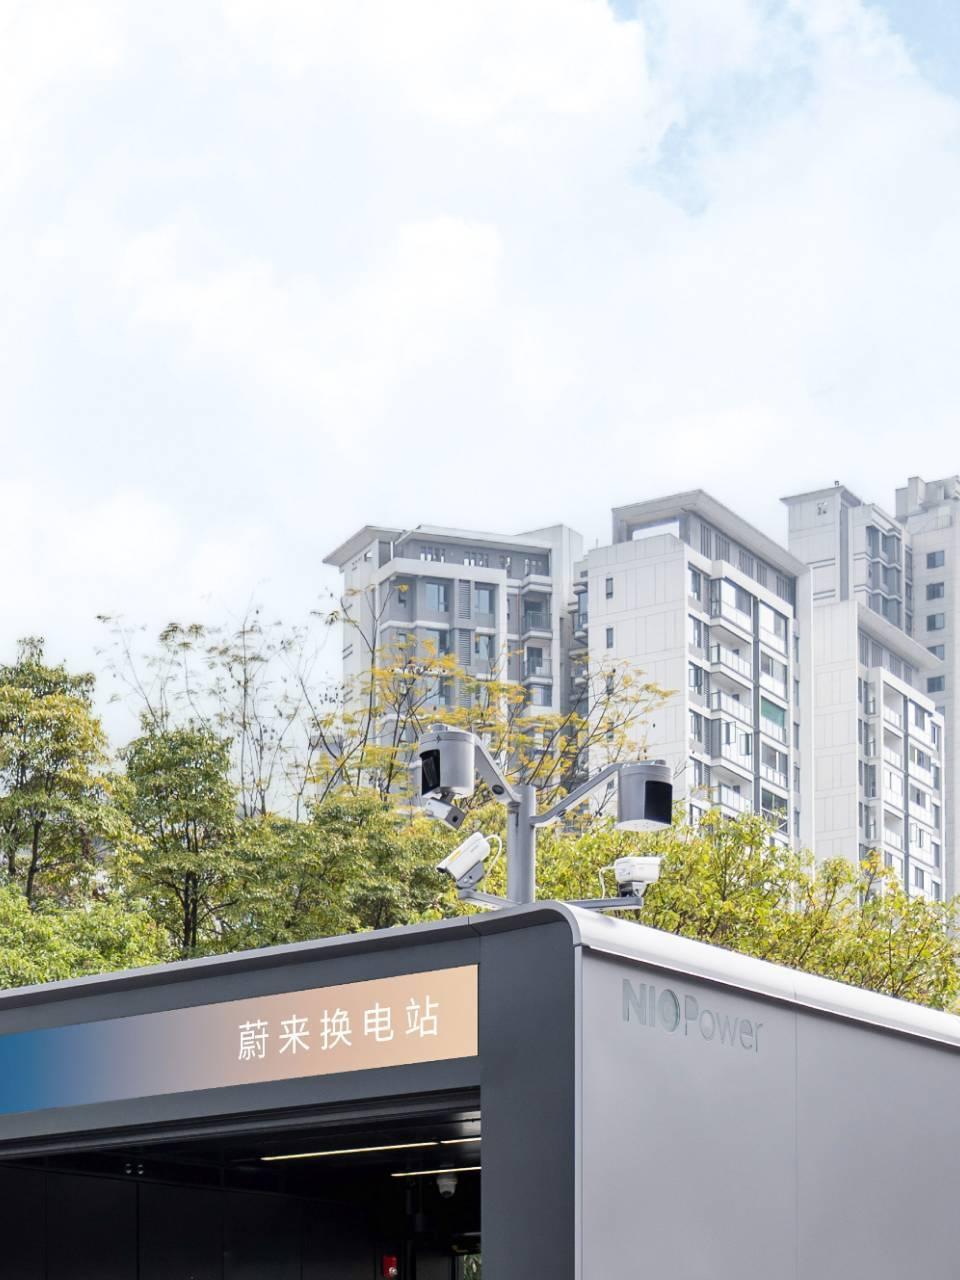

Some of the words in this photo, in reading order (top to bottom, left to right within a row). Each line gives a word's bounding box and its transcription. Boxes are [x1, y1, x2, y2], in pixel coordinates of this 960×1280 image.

[238, 995, 440, 1060] 蔚来换电站
